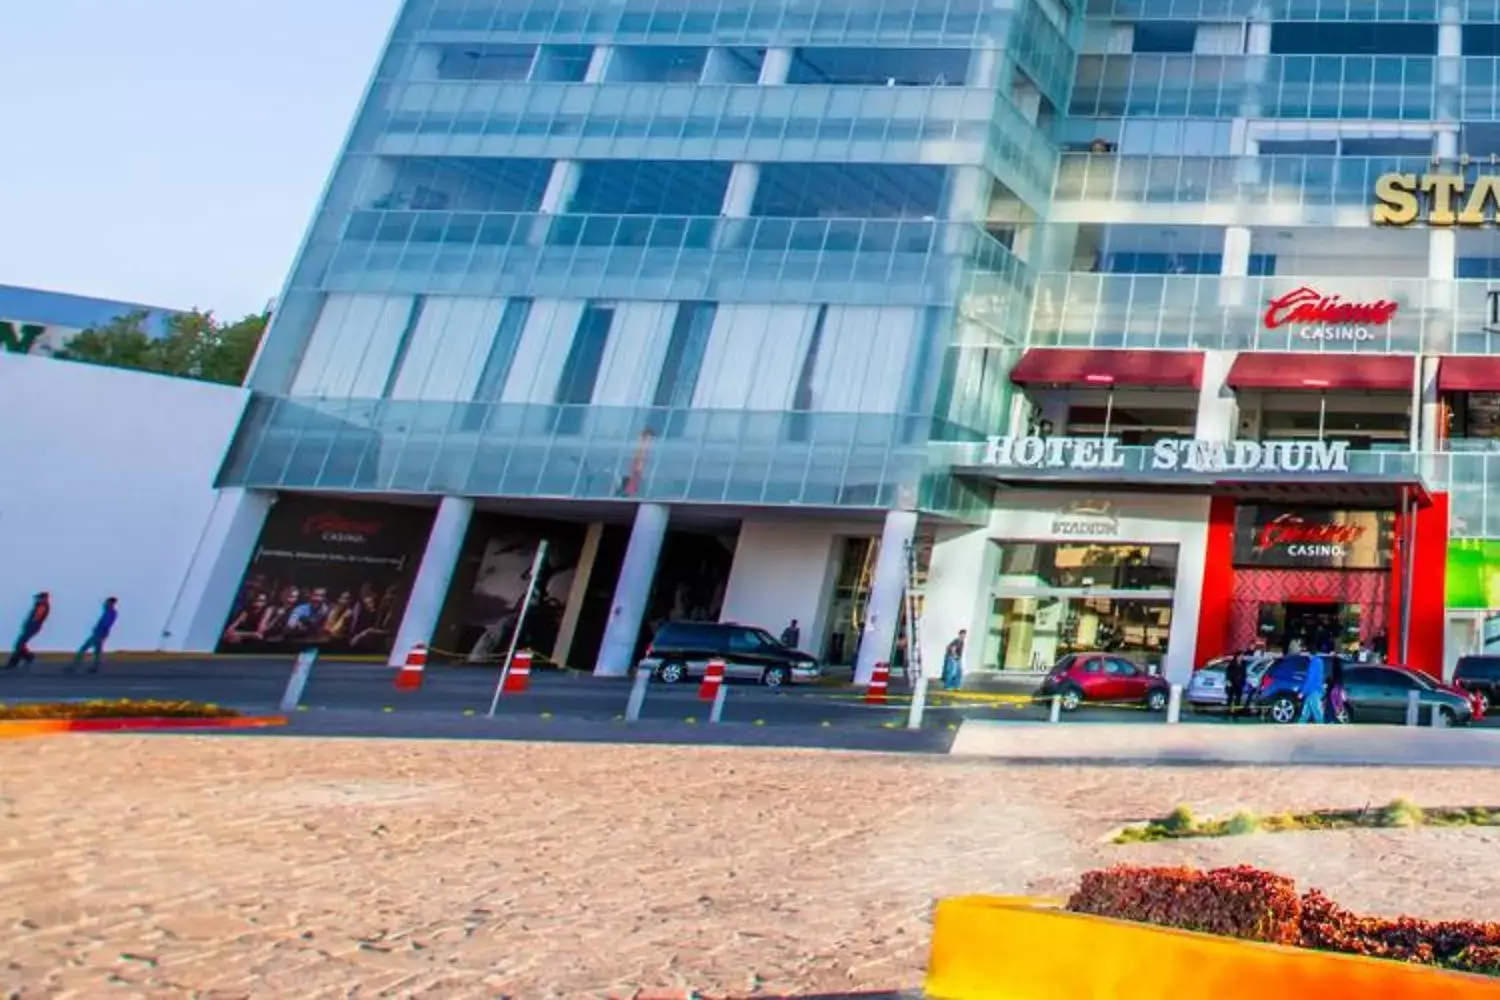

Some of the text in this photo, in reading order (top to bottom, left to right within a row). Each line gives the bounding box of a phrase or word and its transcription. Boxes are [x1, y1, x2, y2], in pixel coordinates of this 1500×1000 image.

[1300, 326, 1368, 340] CASINO
[982, 435, 1351, 472] HOTEL STADIUM
[1287, 543, 1346, 557] CASINO
